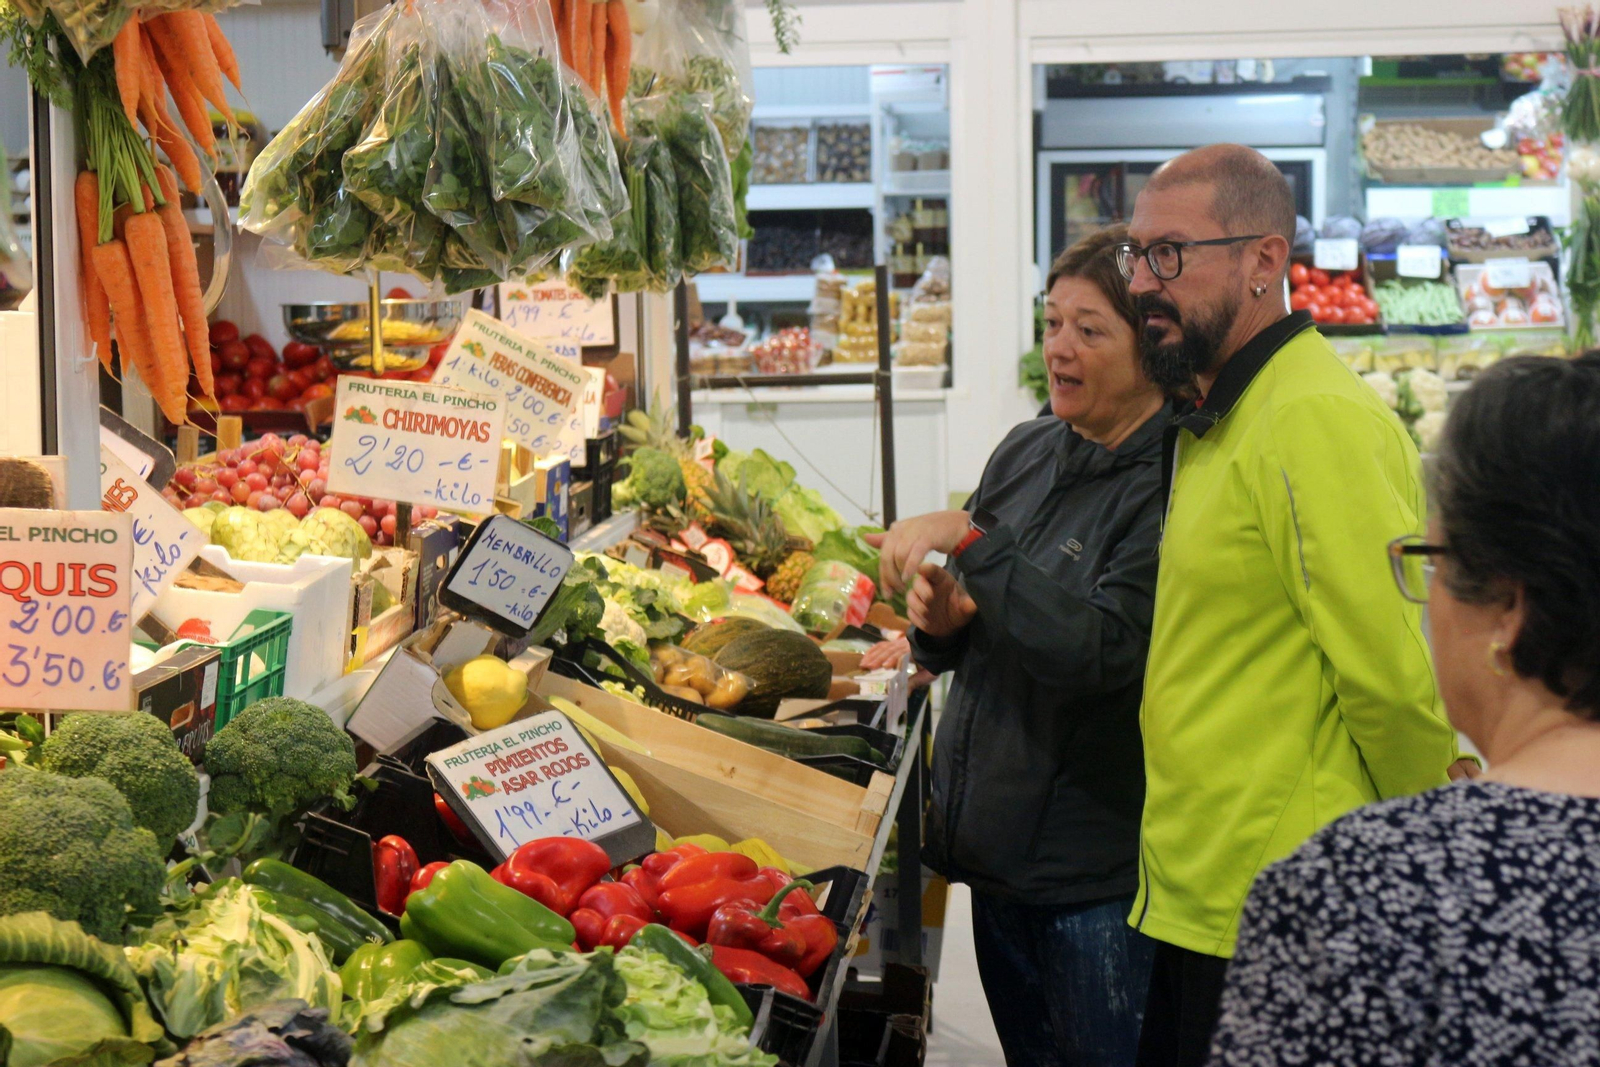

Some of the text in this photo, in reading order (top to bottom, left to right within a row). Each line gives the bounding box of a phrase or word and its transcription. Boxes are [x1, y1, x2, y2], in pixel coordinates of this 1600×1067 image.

[472, 321, 523, 353] FRUTERIA
[525, 350, 537, 362] EL
[541, 357, 582, 385] PINCHO
[490, 351, 519, 378] PERAS
[348, 382, 497, 411] FRUTERIA EL PINCHO
[382, 408, 491, 443] CHIRIMOYAS
[344, 435, 425, 476] 2'20
[28, 526, 118, 544] PINCHO
[0, 560, 118, 603] QUIS
[443, 720, 563, 769] FRUTERIA EL PINCHO
[484, 737, 569, 778] PIMIENTOS
[501, 752, 591, 796] ASAR ROJOS
